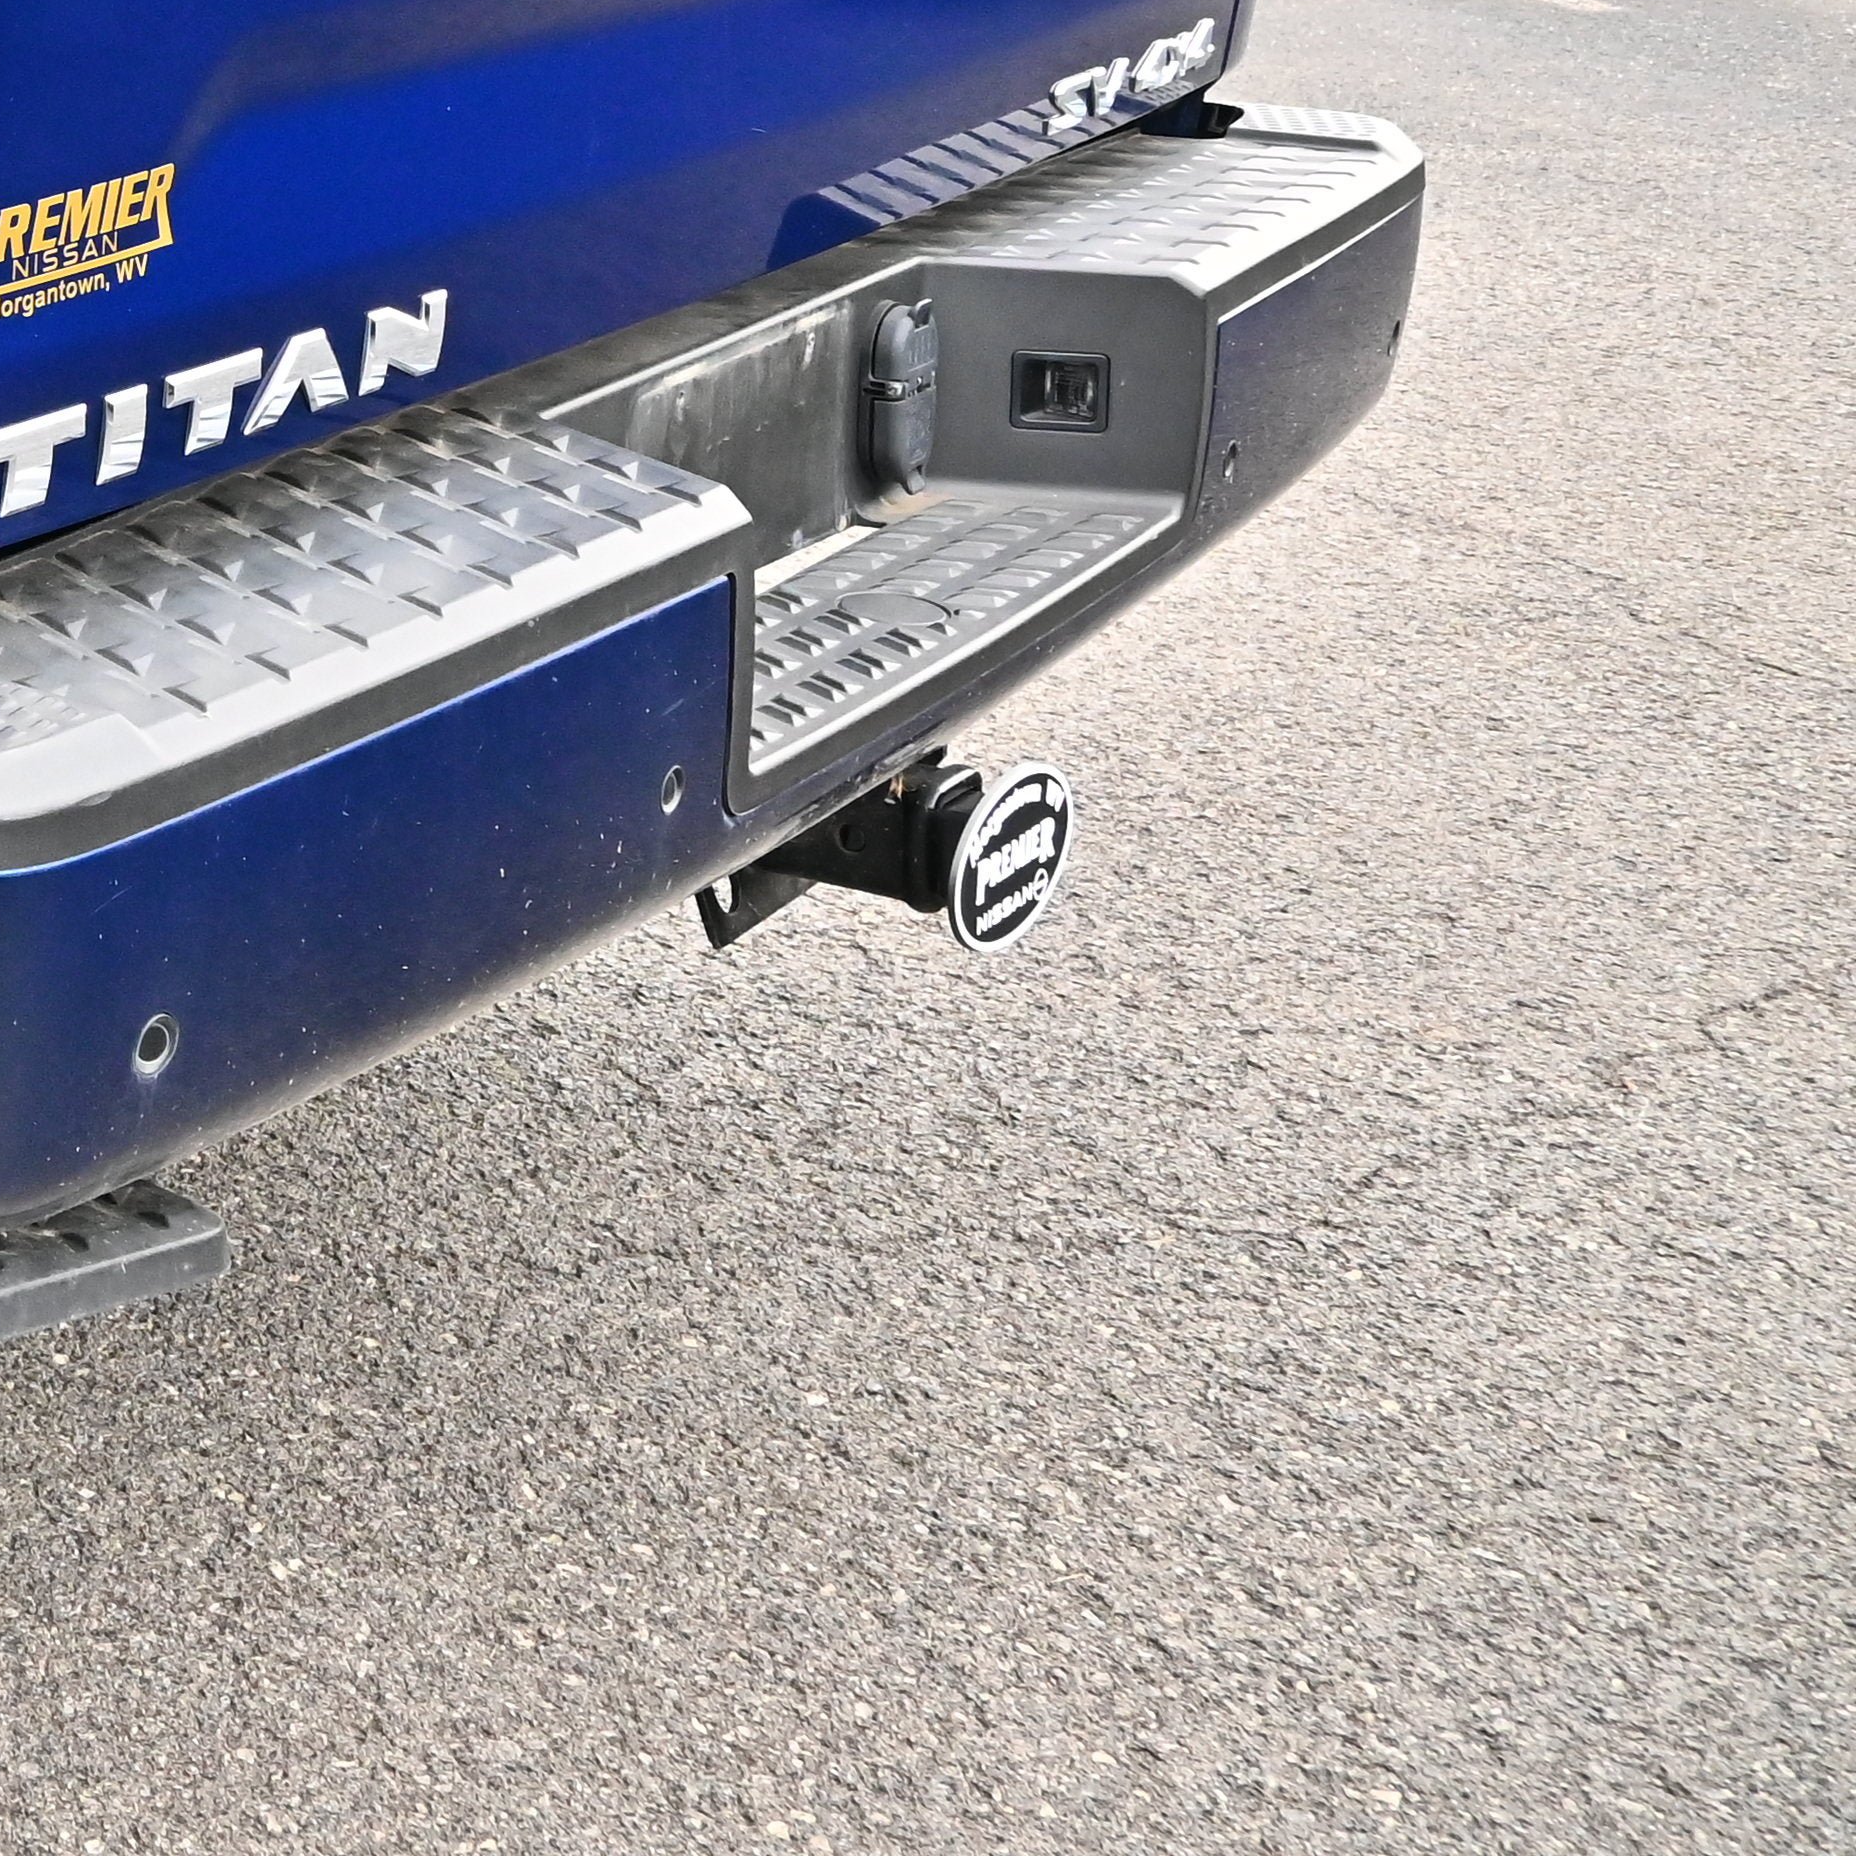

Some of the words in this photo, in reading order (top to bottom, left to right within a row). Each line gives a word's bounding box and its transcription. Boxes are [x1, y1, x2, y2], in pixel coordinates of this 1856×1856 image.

[11, 230, 119, 281] NISSAN
[115, 253, 149, 284] WV
[975, 815, 1056, 907] PREMIER
[975, 885, 1035, 936] NISSAN
